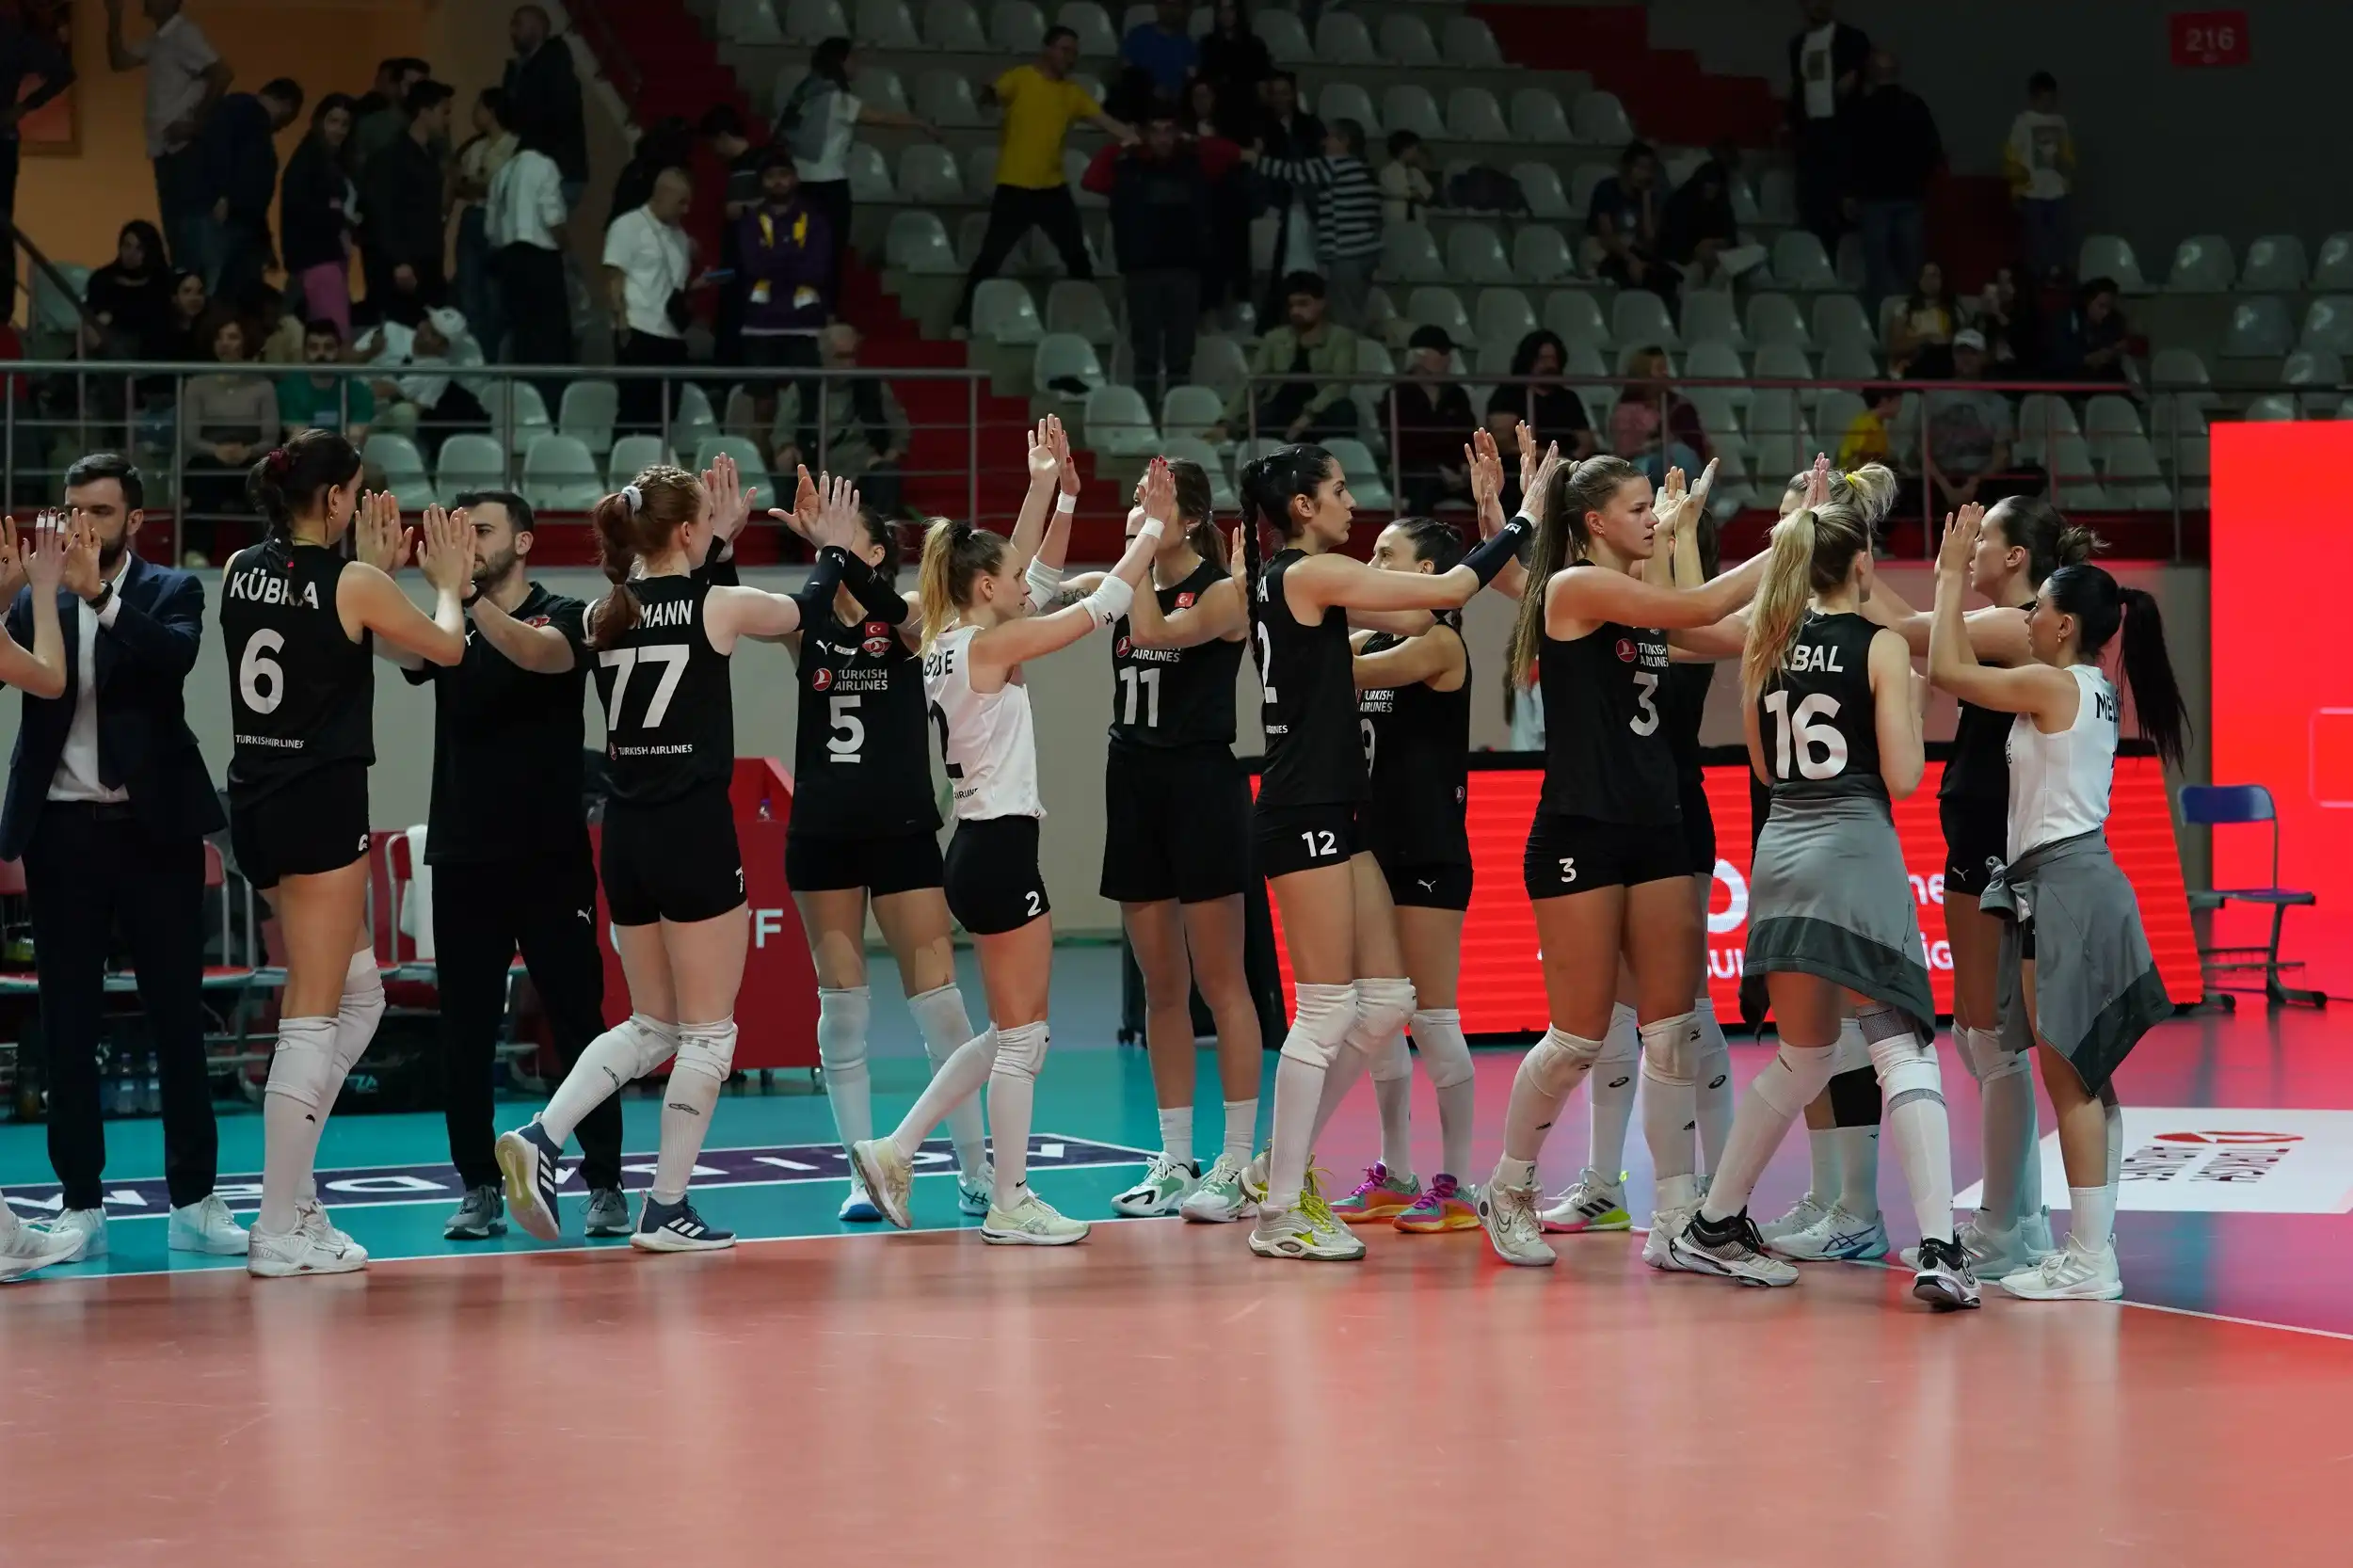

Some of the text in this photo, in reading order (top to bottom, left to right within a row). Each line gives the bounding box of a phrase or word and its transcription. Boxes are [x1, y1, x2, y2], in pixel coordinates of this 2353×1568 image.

[2185, 24, 2235, 52] 216
[629, 600, 693, 630] MANN
[1131, 648, 1181, 664] AIRLINES
[1773, 644, 1844, 673] BAL
[239, 628, 285, 714] 6
[838, 668, 888, 680] TURKISH
[598, 644, 690, 731] 77
[834, 680, 888, 692] AIRLINES
[1119, 665, 1160, 728] 11
[1629, 670, 1659, 737] 3
[825, 695, 865, 754] 5
[1764, 689, 1849, 780] 16
[650, 744, 693, 755] AIRLINES
[1301, 830, 1337, 857] 12
[1559, 857, 1577, 883] 3
[1025, 890, 1042, 917] 2
